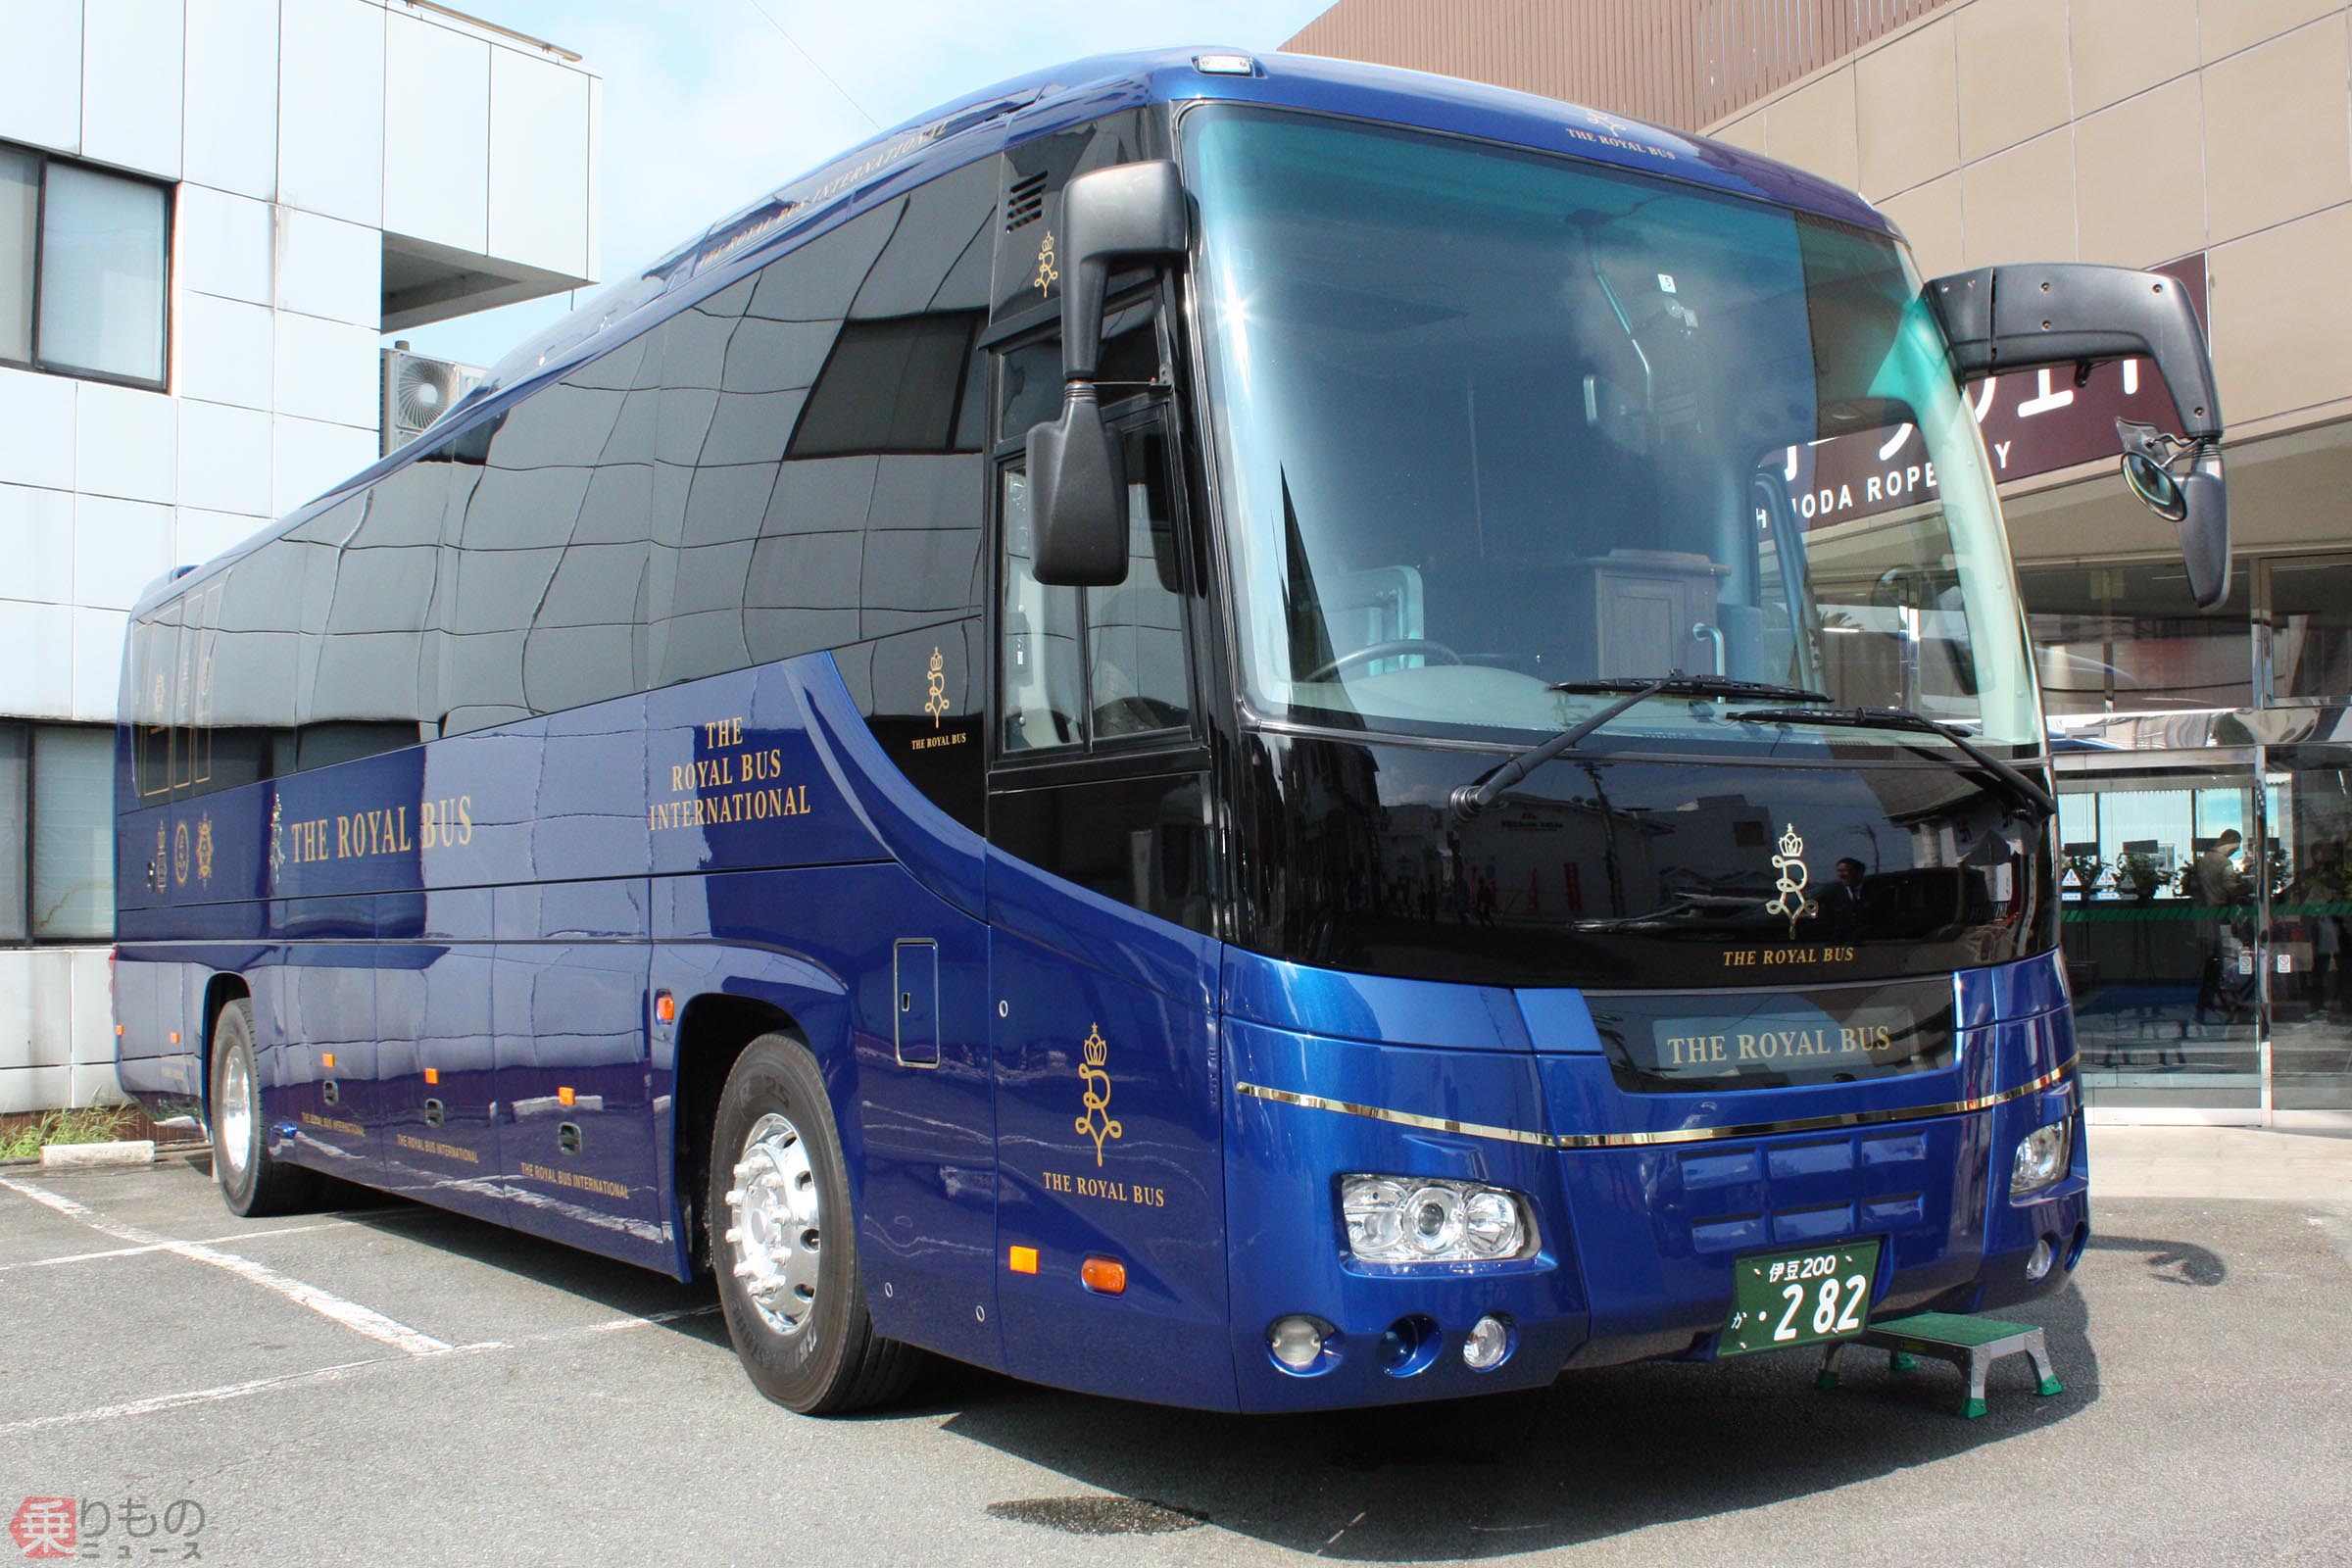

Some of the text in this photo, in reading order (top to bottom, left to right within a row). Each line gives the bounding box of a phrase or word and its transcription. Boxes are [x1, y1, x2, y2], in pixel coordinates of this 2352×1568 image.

[811, 120, 951, 205] INTERNATIONAL
[1566, 126, 1677, 161] THE ROYAL BUS
[705, 716, 744, 750] THE
[911, 732, 967, 751] THE ROYAL BUS
[671, 748, 782, 793] ROYAL BUS
[649, 784, 811, 832] INTERNATIONAL
[291, 795, 471, 863] THE ROYAL BUS
[1723, 947, 1854, 966] THE ROYAL BUS
[1667, 1025, 1891, 1064] THE ROYAL BUS
[520, 1162, 629, 1200] THE ROYAL BUS INTERNATIONAL
[1043, 1171, 1164, 1207] THE ROYAL BUS
